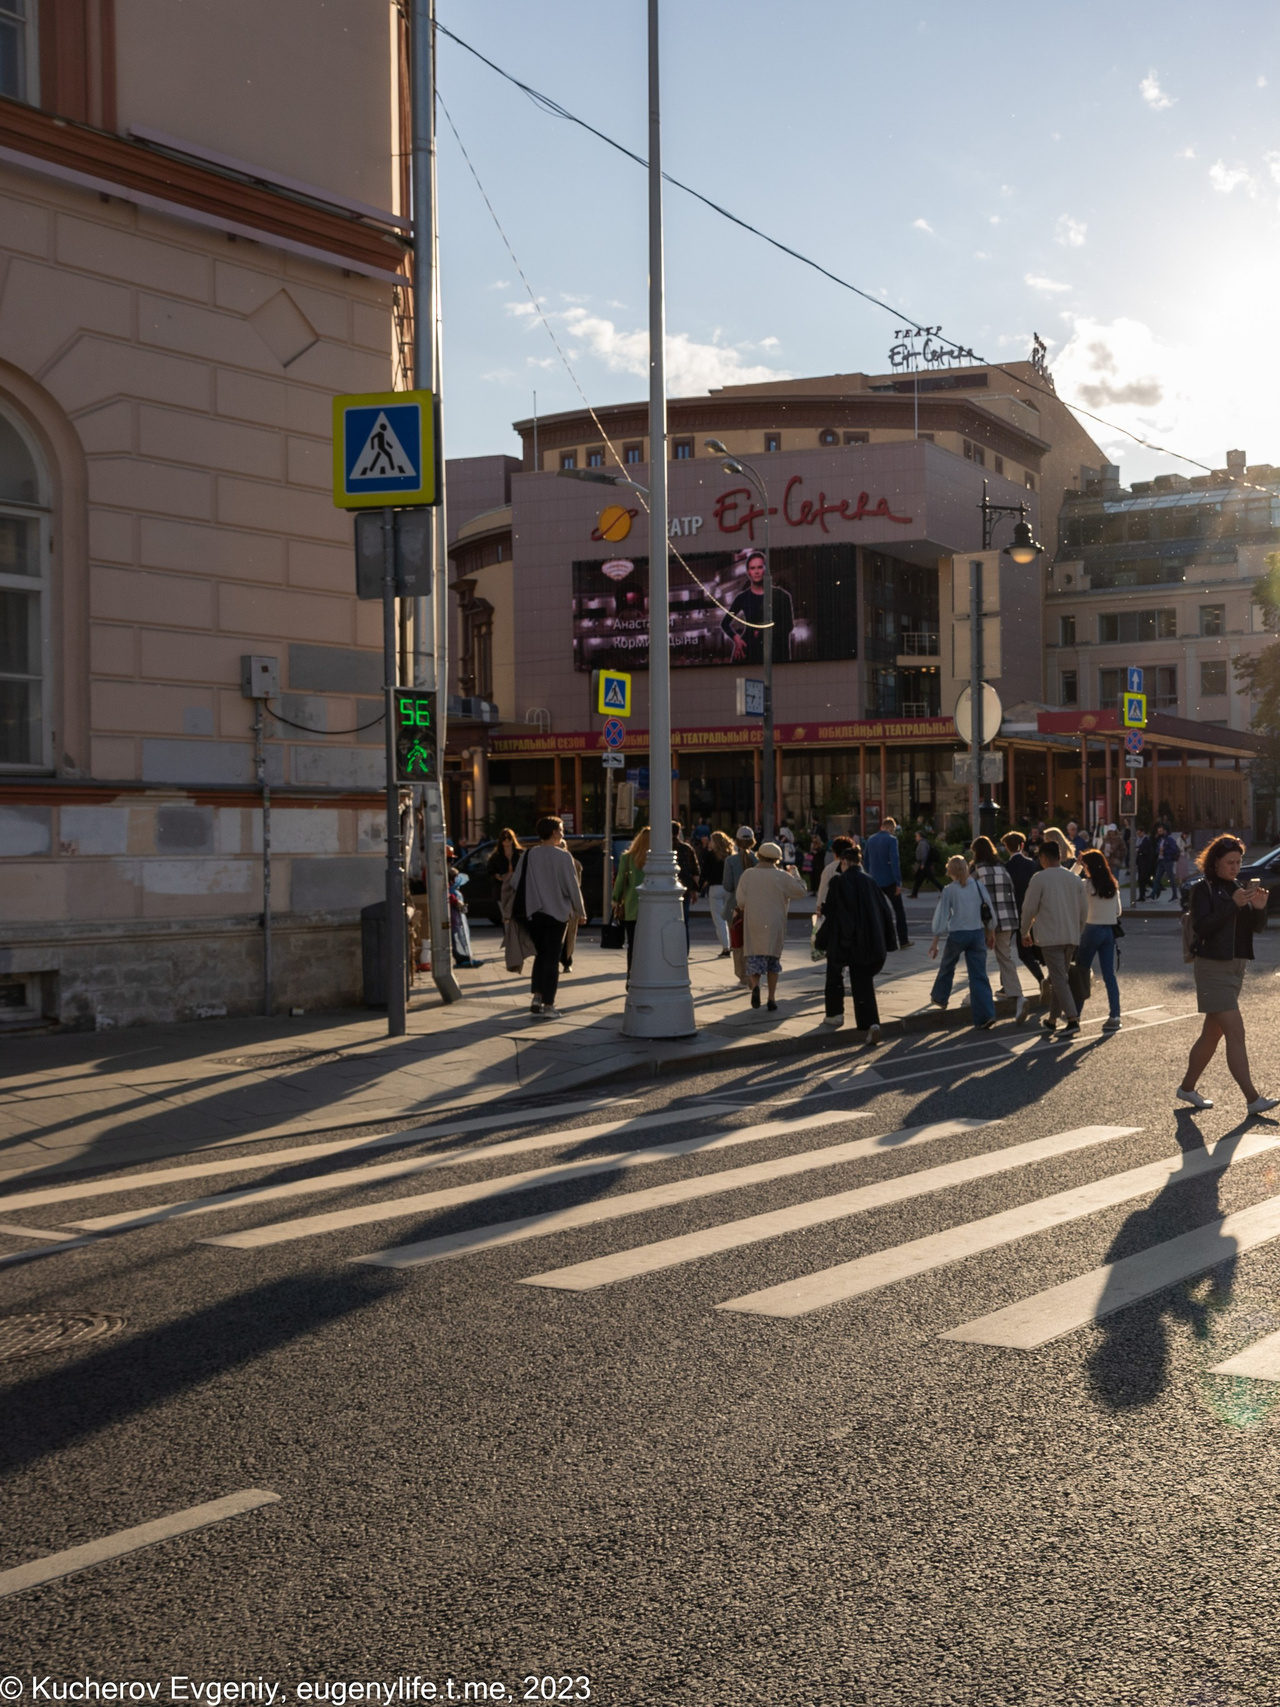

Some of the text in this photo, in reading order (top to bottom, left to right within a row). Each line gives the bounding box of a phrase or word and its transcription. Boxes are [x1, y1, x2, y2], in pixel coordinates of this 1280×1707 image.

[895, 326, 942, 339] ТЕАТР
[668, 515, 703, 537] АТР
[400, 699, 430, 726] 56
[682, 729, 749, 745] ТЕАТРАЛЬНЫЙ
[750, 729, 781, 743] СЕН
[818, 723, 883, 739] ЮБИЛЕЙНЫЙ
[494, 736, 586, 751] ТЕАТРАЛЬНЫЙ СЕЗОН
